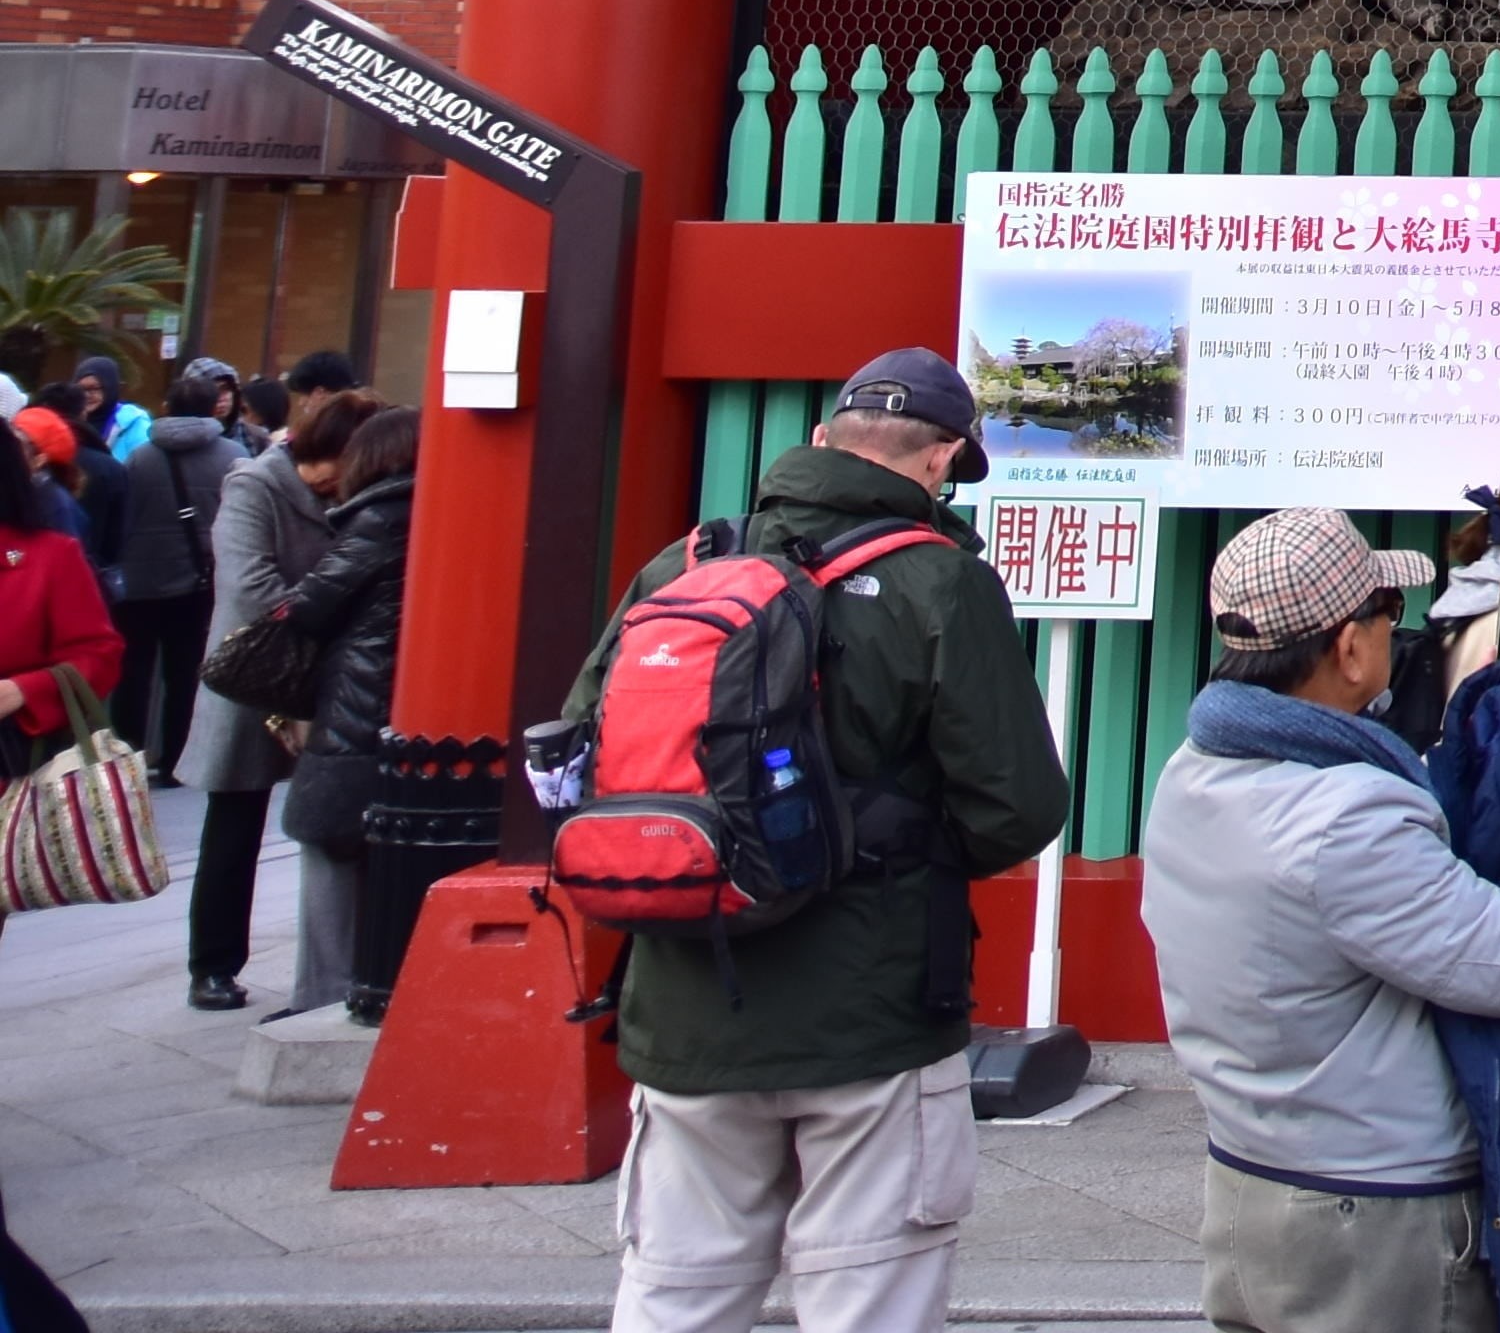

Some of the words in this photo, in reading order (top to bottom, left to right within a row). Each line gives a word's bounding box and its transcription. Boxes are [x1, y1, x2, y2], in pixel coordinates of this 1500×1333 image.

[131, 88, 211, 112] Hotel
[298, 19, 491, 131] KAMINARIMON
[487, 121, 562, 170] GATE
[149, 134, 322, 161] Kaminarimon
[998, 181, 1125, 208] 国指定名勝
[994, 503, 1139, 600] 開催中
[641, 824, 677, 838] GUIDE
